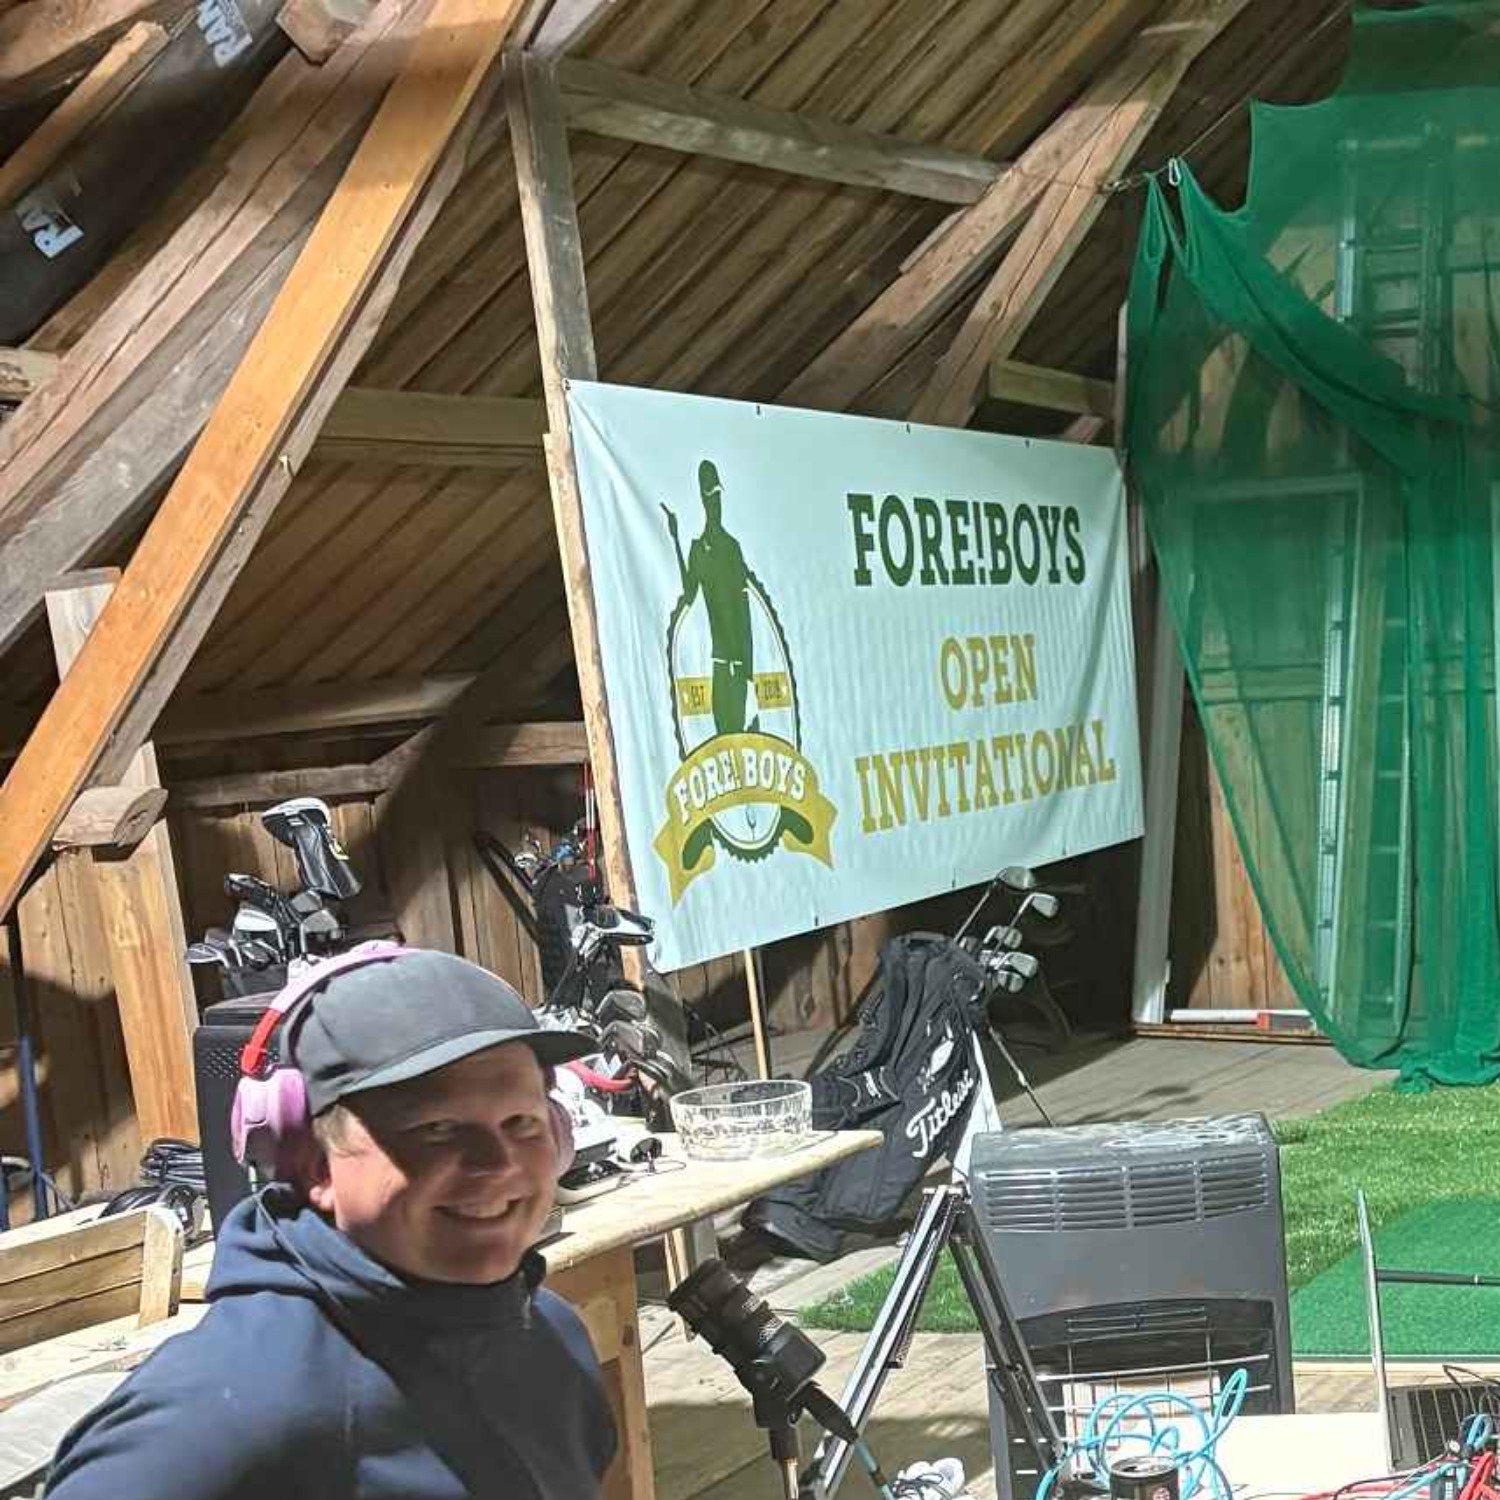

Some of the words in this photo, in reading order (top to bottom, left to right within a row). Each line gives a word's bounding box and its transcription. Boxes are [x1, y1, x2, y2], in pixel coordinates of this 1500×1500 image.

[847, 493, 1086, 587] FORE!BOYS
[940, 634, 1038, 711] OPEN
[741, 748, 806, 801] BOYS
[854, 719, 1117, 834] INVITATIONAL
